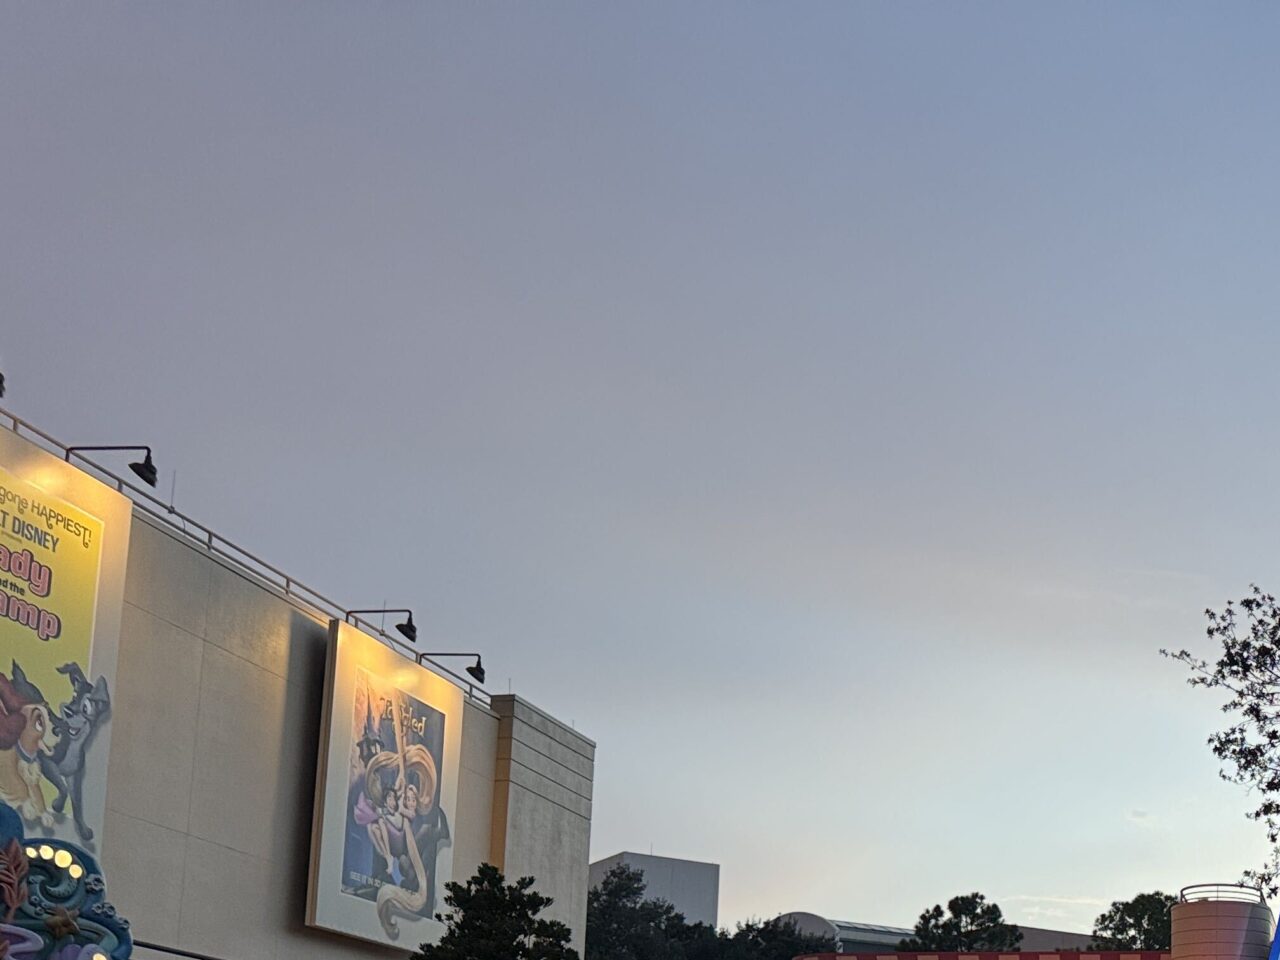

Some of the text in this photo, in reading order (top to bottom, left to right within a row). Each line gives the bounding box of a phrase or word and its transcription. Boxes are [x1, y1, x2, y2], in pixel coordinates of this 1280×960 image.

[12, 516, 59, 553] DISNEY
[31, 500, 92, 549] HAPPIEST!
[10, 581, 25, 596] the
